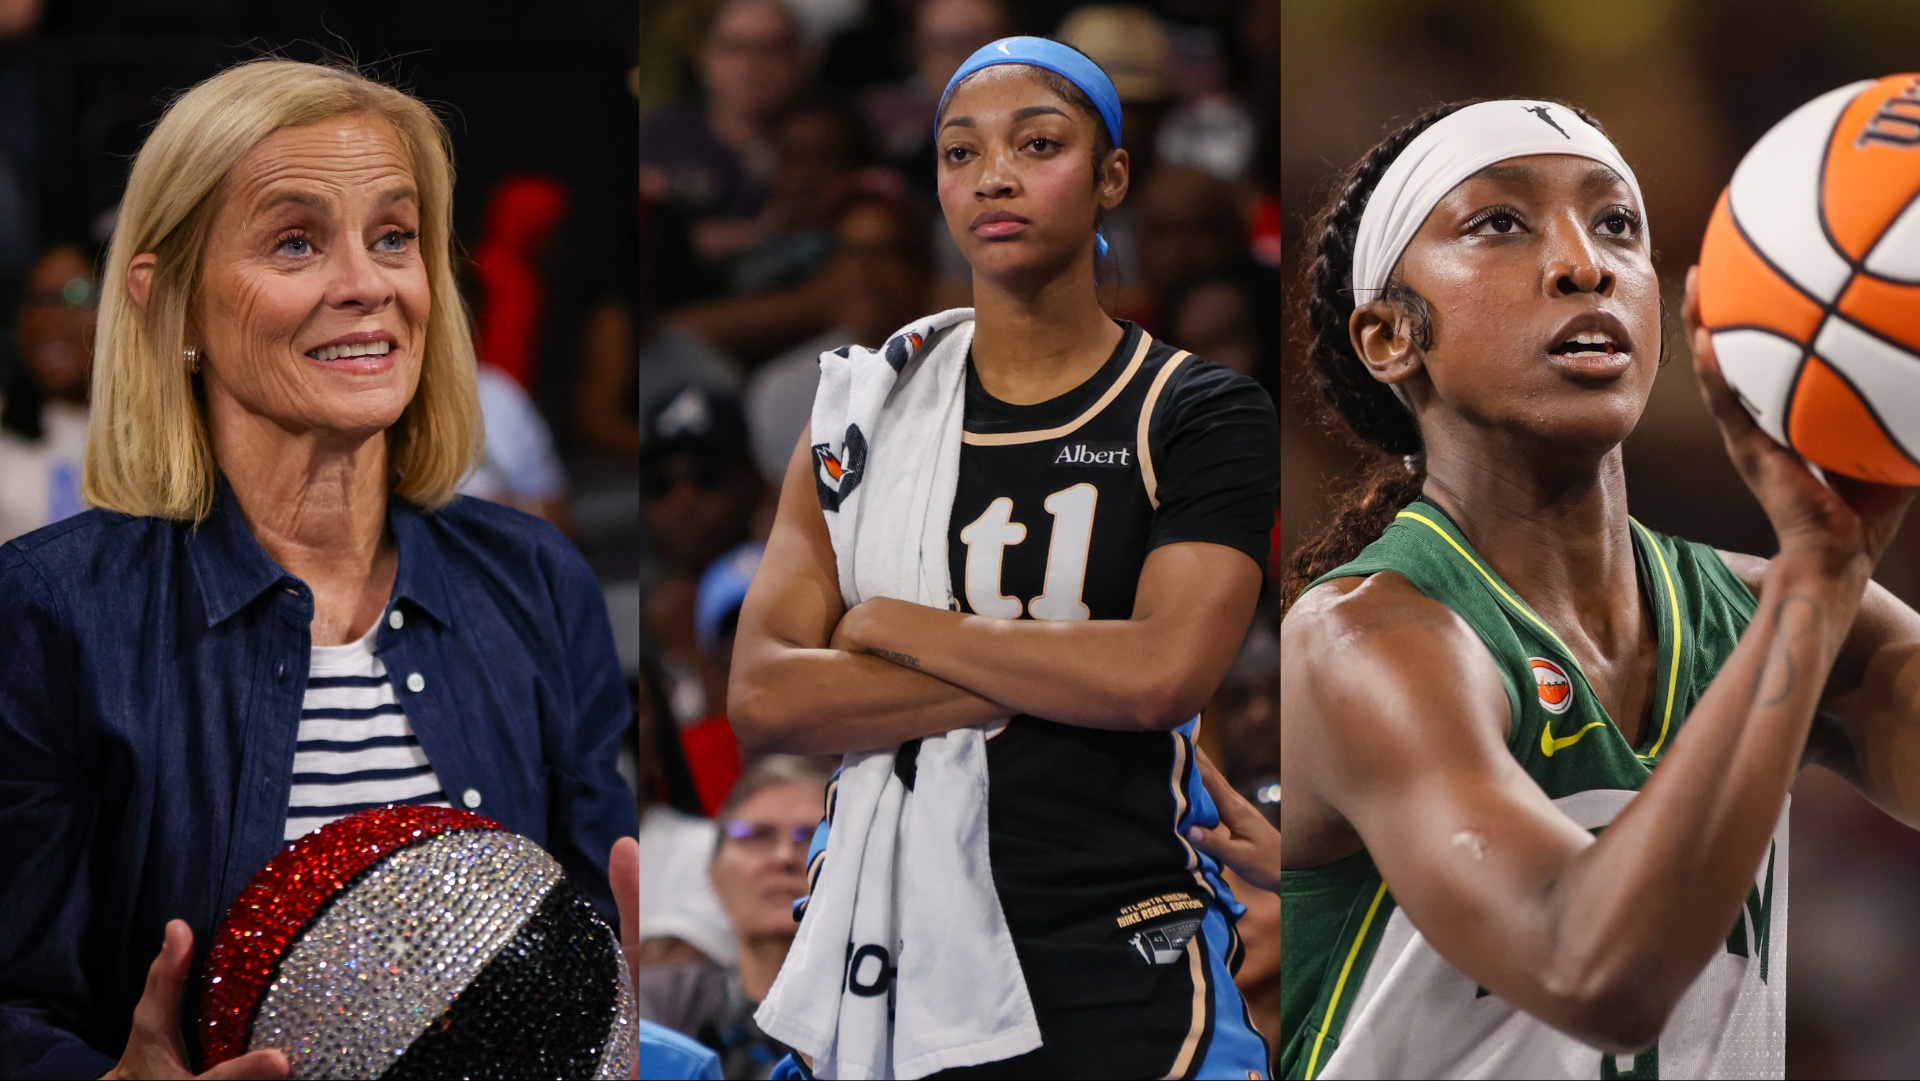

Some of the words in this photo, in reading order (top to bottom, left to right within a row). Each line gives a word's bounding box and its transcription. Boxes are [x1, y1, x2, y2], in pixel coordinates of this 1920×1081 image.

[1054, 444, 1130, 466] Albert
[1116, 911, 1142, 928] NIKE
[1140, 904, 1171, 920] REBEL
[1168, 899, 1204, 912] EDITION
[1120, 896, 1163, 915] ATLANTA
[1161, 892, 1191, 903] DREAM
